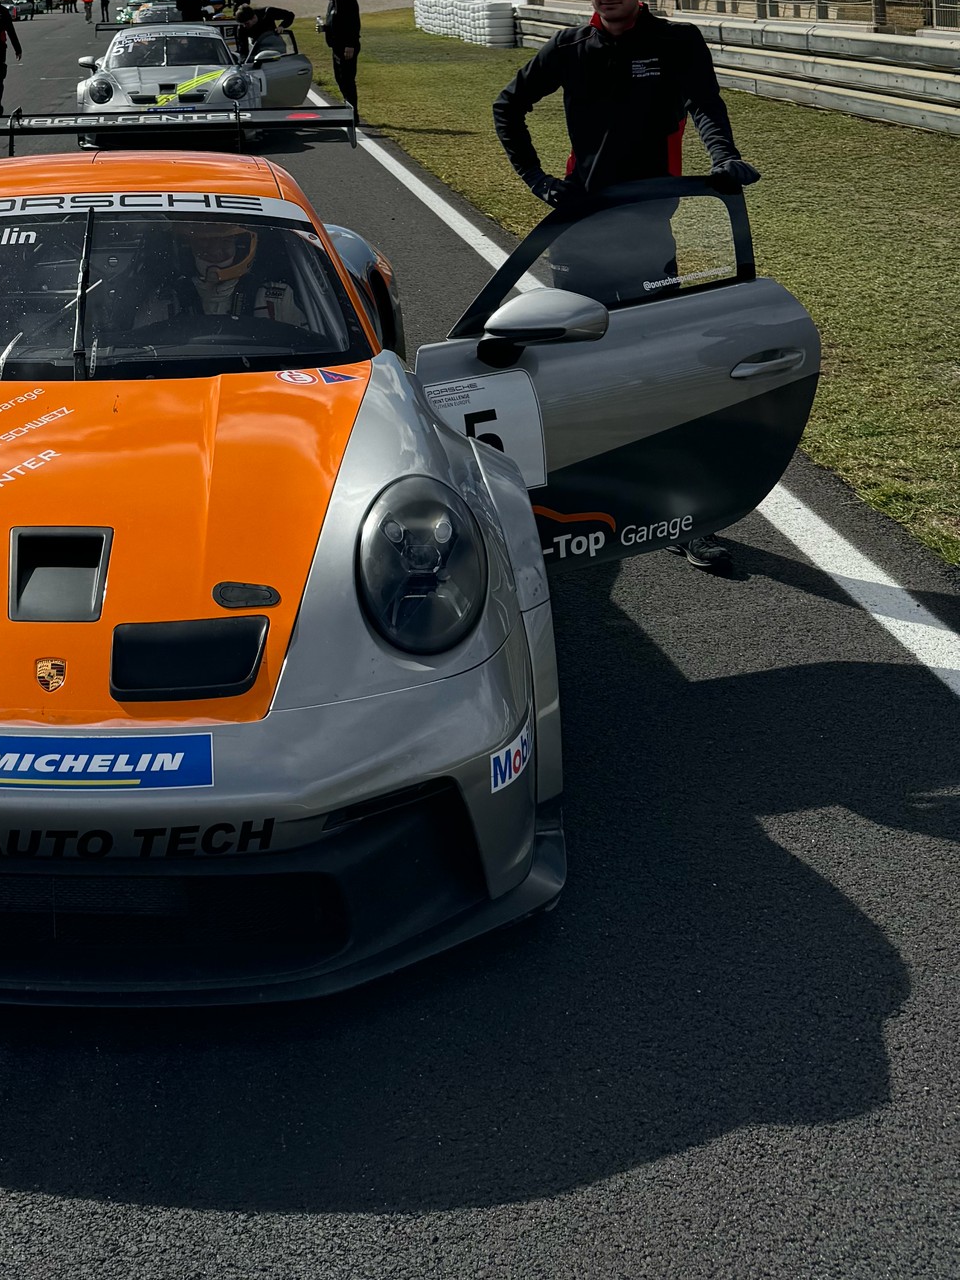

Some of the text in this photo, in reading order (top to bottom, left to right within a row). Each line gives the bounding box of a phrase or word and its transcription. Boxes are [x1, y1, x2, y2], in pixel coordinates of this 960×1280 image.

[427, 383, 478, 397] PORSCHE
[0, 406, 75, 442] SCHWEIZ
[464, 408, 504, 453] 5
[620, 515, 693, 546] Garage
[133, 818, 275, 858] TECH
